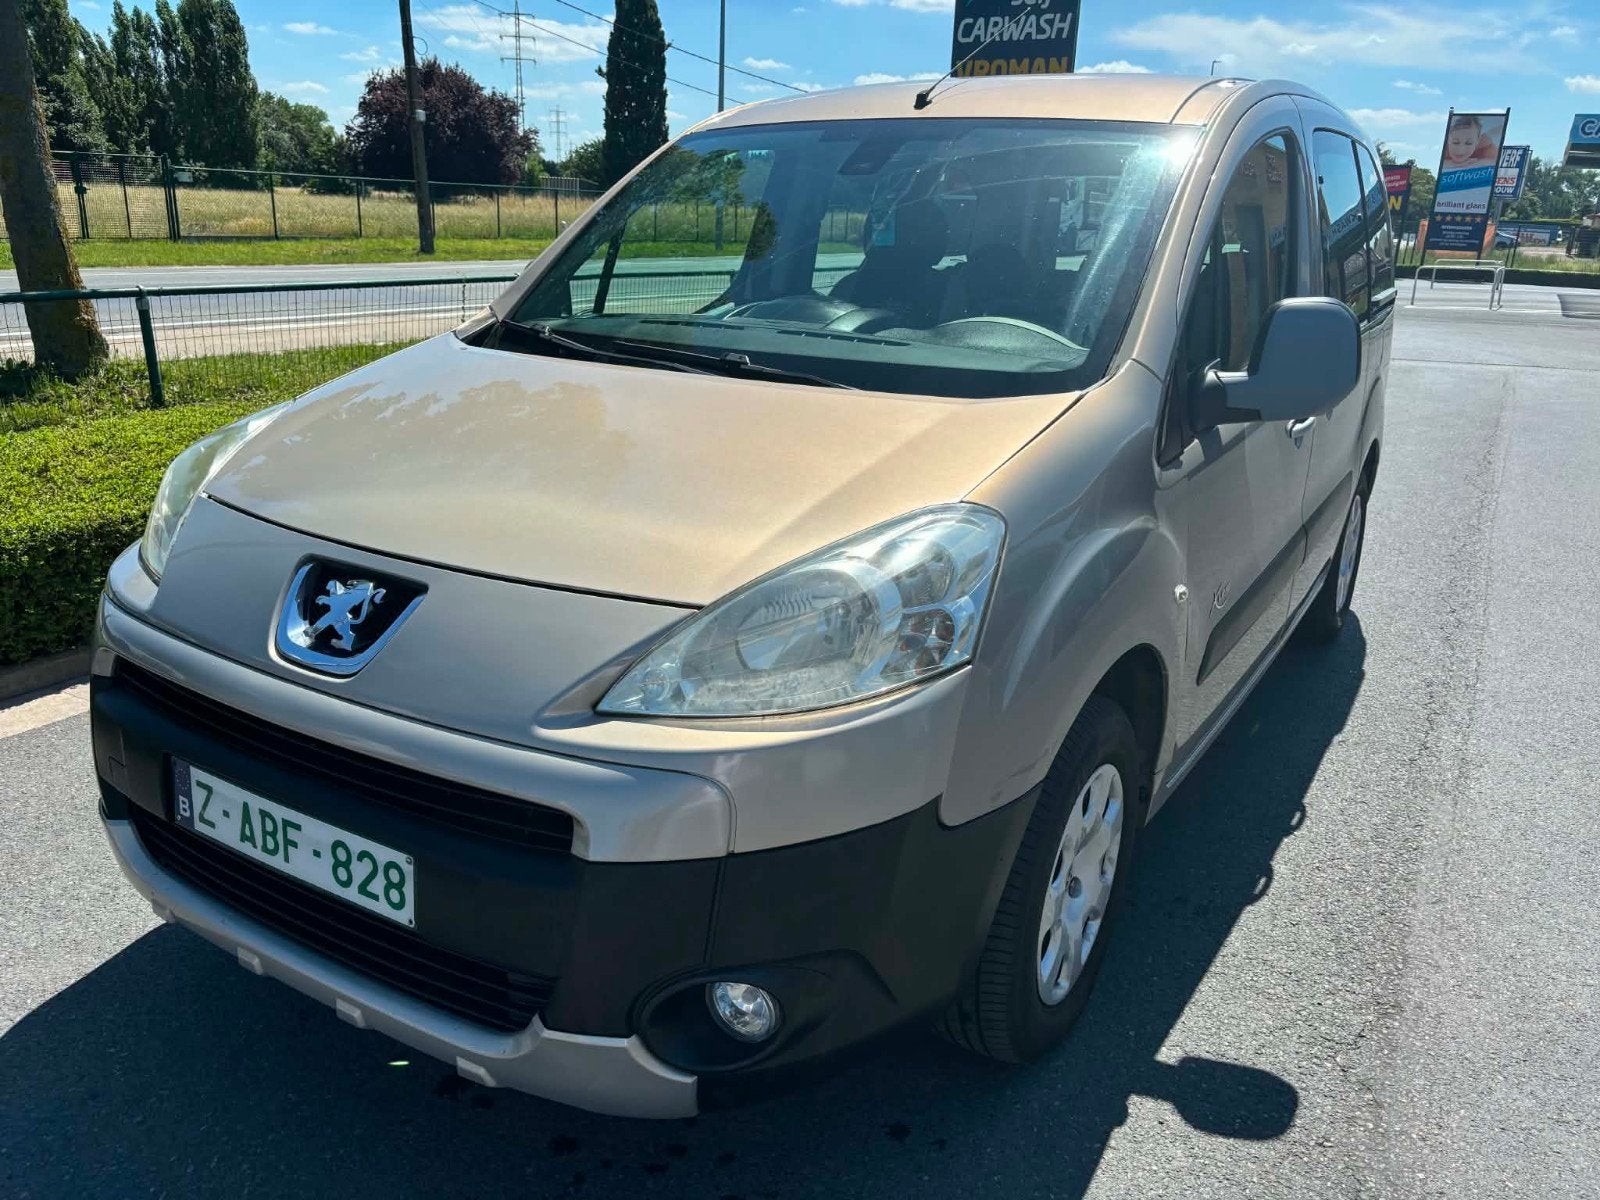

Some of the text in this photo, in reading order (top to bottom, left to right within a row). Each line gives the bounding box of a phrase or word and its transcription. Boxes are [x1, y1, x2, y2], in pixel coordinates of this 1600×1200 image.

[957, 13, 1072, 43] CARWASH
[1441, 167, 1495, 184] softwash
[1436, 200, 1465, 209] brilliant
[178, 795, 191, 818] B
[195, 779, 406, 911] Z-ABF-828
